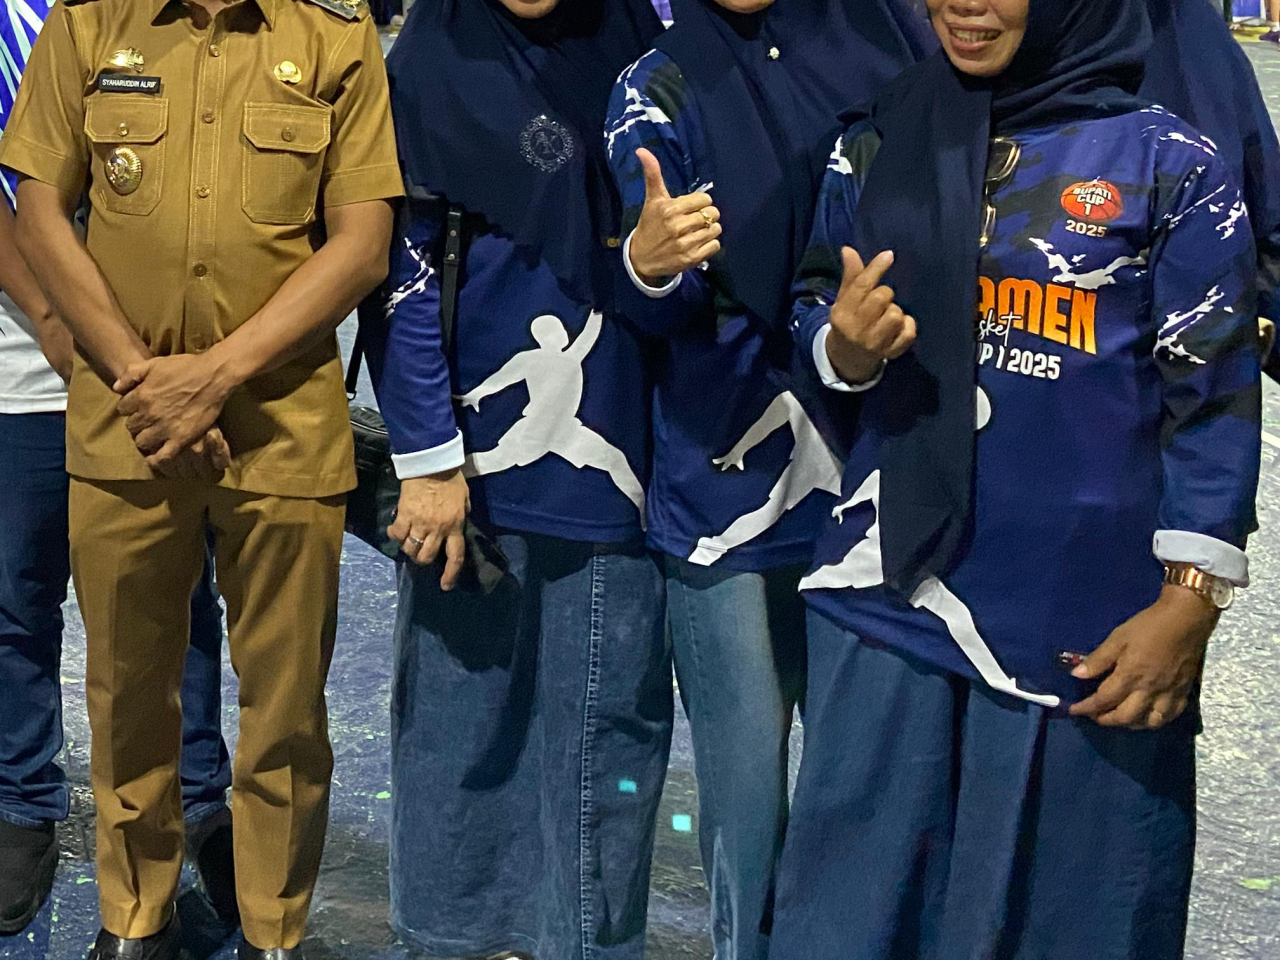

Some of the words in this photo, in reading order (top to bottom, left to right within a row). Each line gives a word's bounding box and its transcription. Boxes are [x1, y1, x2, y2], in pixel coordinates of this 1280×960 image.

[1072, 186, 1113, 202] BUPATI
[1076, 194, 1105, 207] CUP
[1083, 203, 1092, 216] 1
[1064, 219, 1108, 238] 2025
[1006, 348, 1062, 381] 2025
